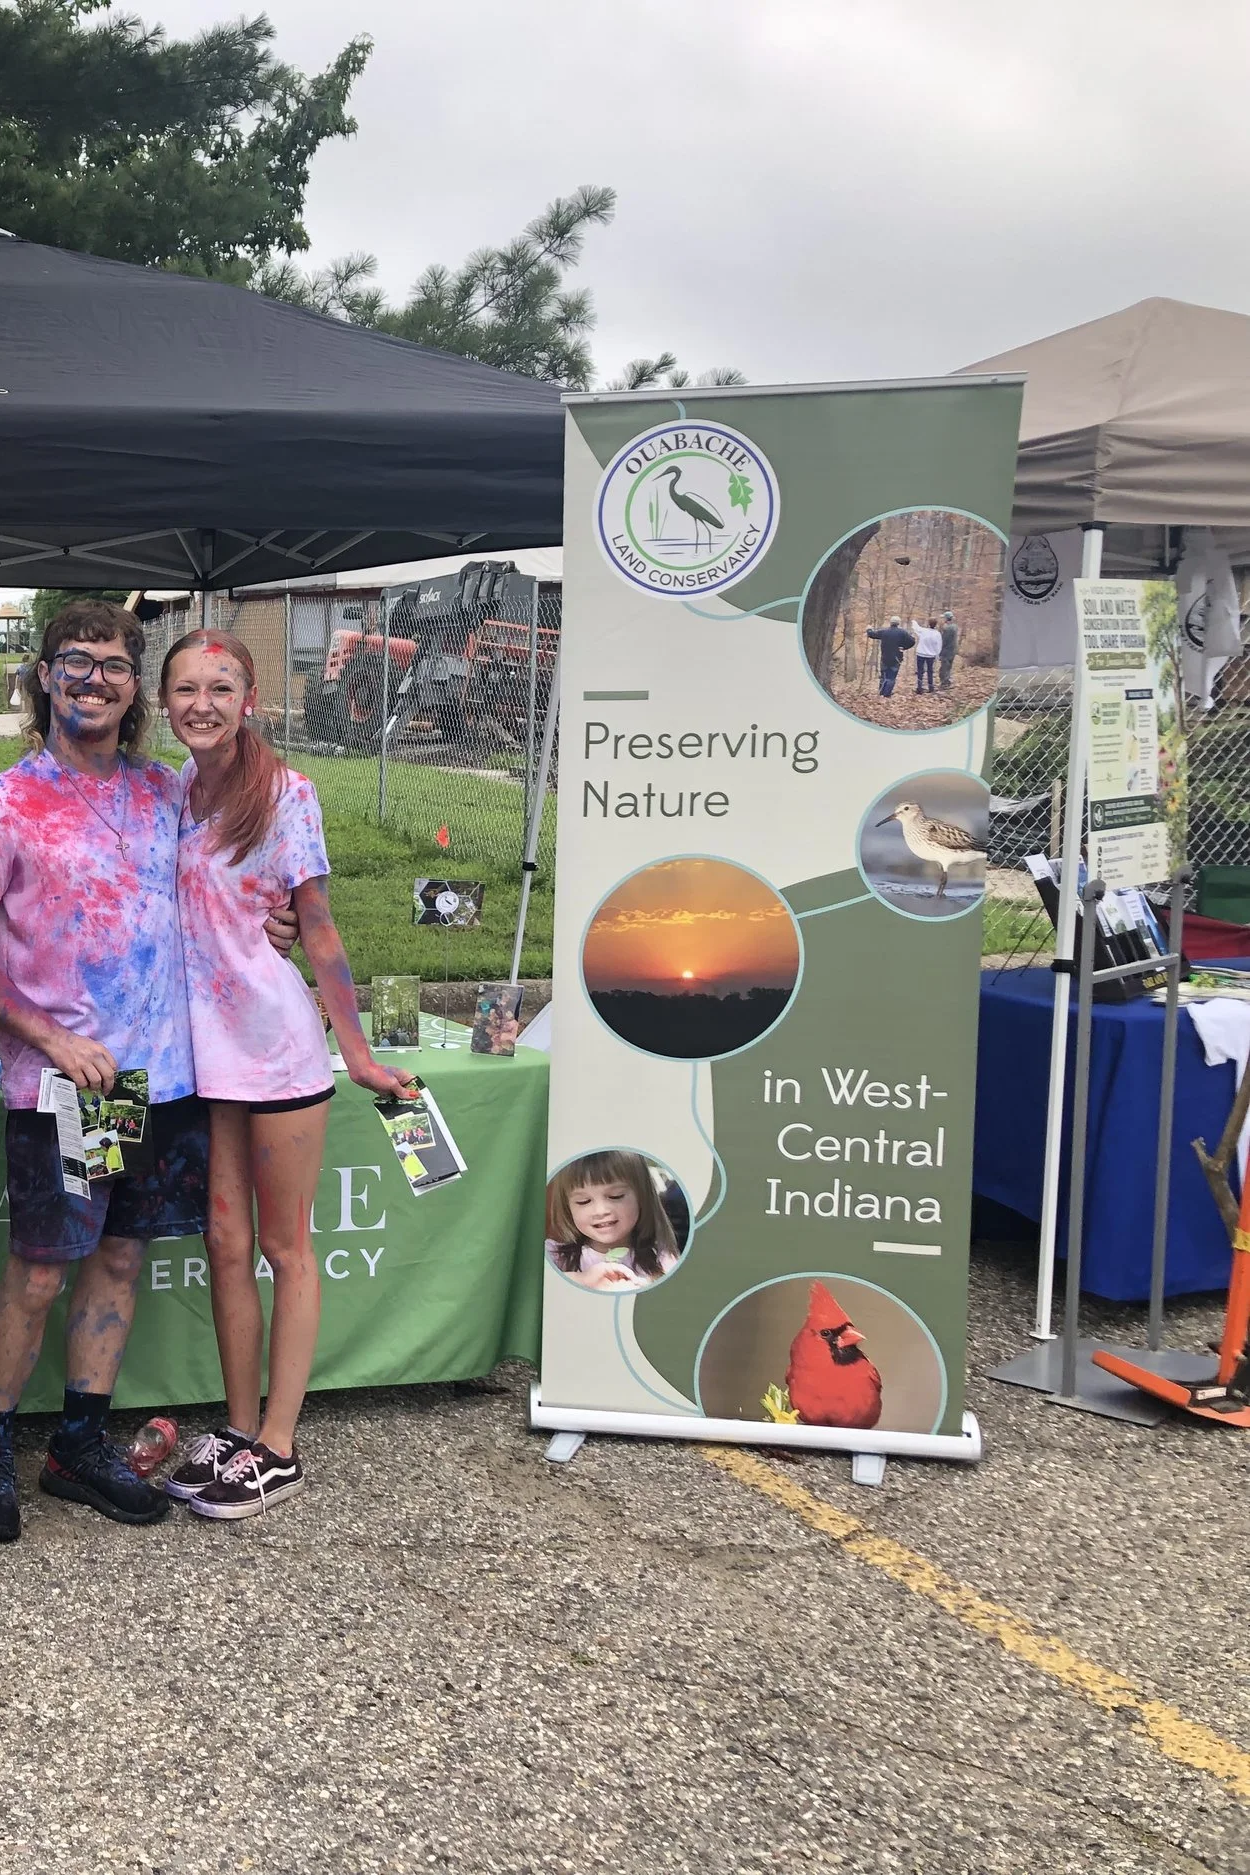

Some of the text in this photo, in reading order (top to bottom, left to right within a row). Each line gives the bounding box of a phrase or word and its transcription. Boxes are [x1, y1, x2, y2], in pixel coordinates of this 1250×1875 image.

[625, 432, 752, 475] OUABACHE
[611, 523, 761, 588] LAND CONSERVANCY
[583, 721, 821, 774] Preserving
[582, 779, 730, 819] Nature
[763, 1067, 949, 1110] in West-
[777, 1122, 945, 1167] Central
[765, 1178, 942, 1224] Indiana
